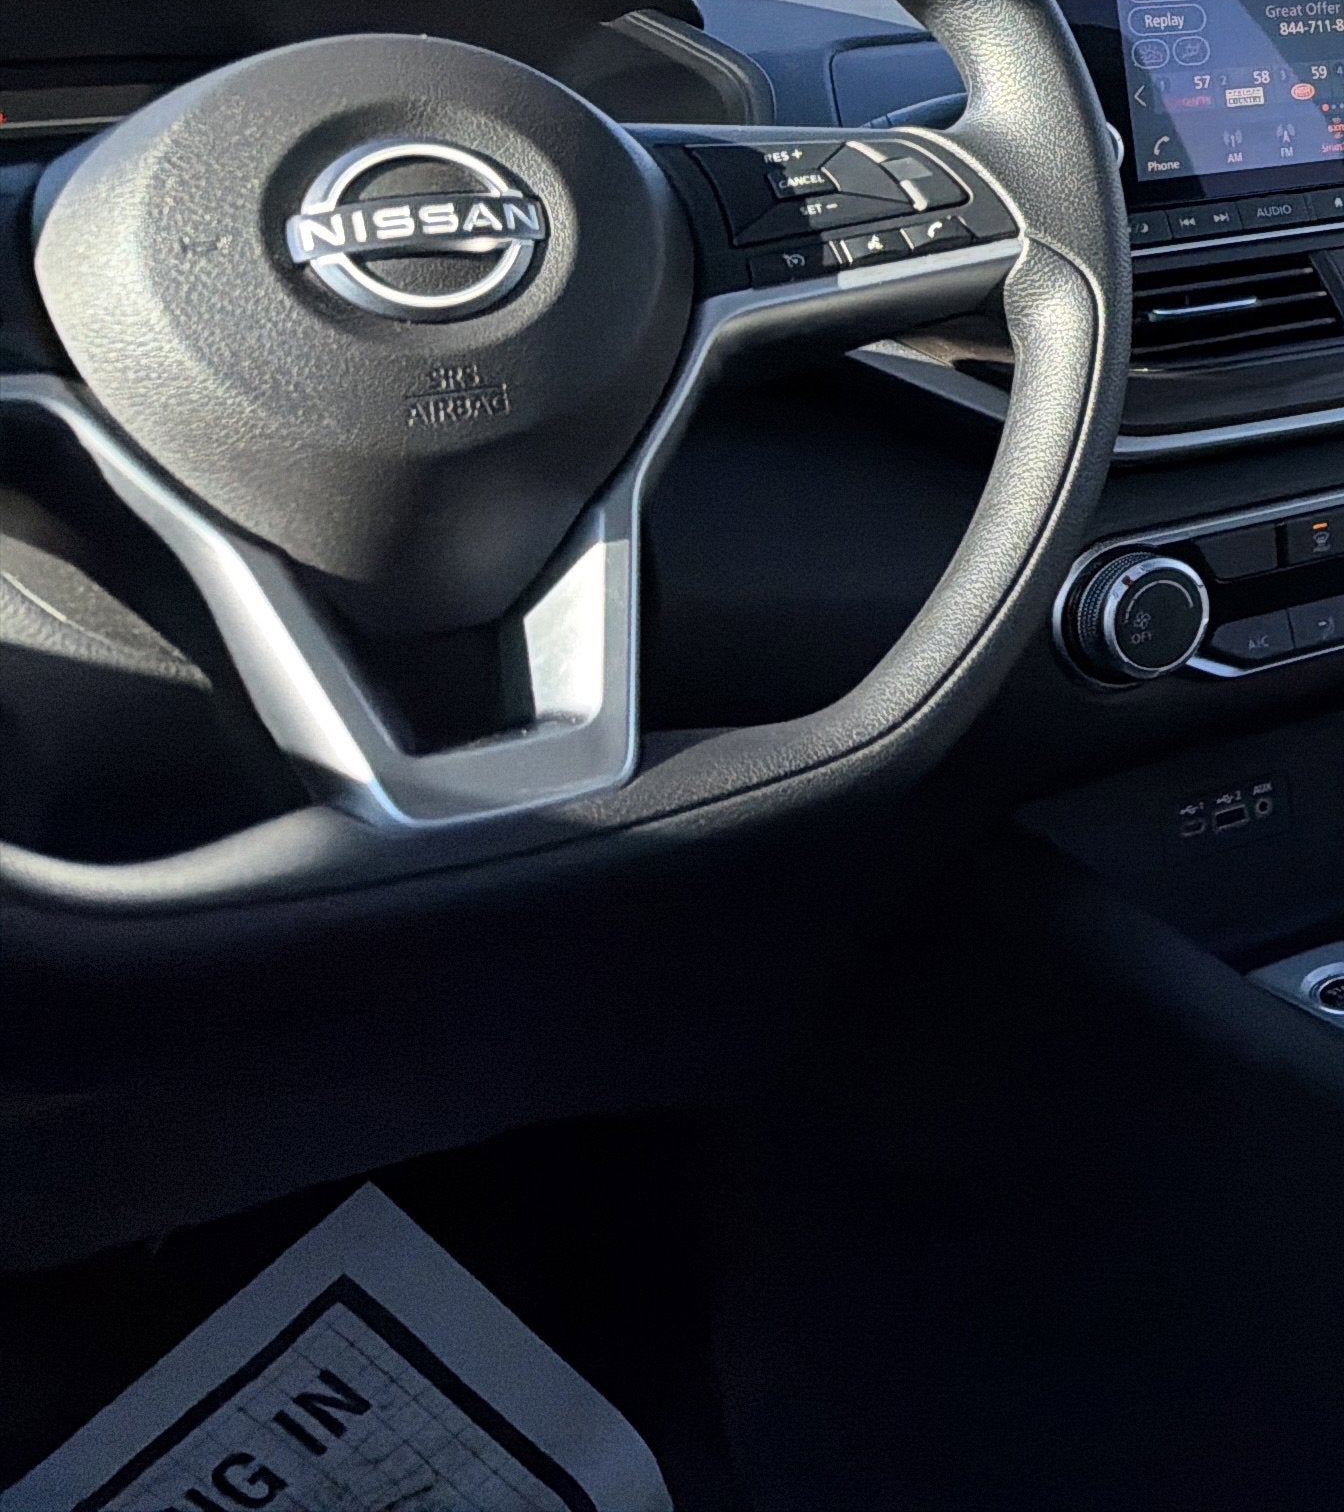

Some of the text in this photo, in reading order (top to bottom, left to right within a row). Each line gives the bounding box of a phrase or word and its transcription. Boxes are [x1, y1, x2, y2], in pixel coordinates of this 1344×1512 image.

[1266, 3, 1303, 19] Great
[1305, 1, 1341, 17] Offer
[1144, 13, 1185, 31] Replay
[1193, 74, 1211, 90] 57
[1253, 70, 1270, 85] 58
[1311, 65, 1328, 80] 59
[764, 150, 790, 164] RES
[1227, 153, 1243, 163] AM
[1281, 147, 1294, 158] FM
[1147, 159, 1181, 172] Phone
[778, 172, 826, 189] CANCEL
[800, 201, 823, 216] SET
[1256, 204, 1292, 218] AUDIO
[300, 202, 541, 252] NISSAN
[1131, 632, 1152, 645] OFF
[1248, 634, 1269, 649] A/C
[272, 1368, 373, 1456] IN
